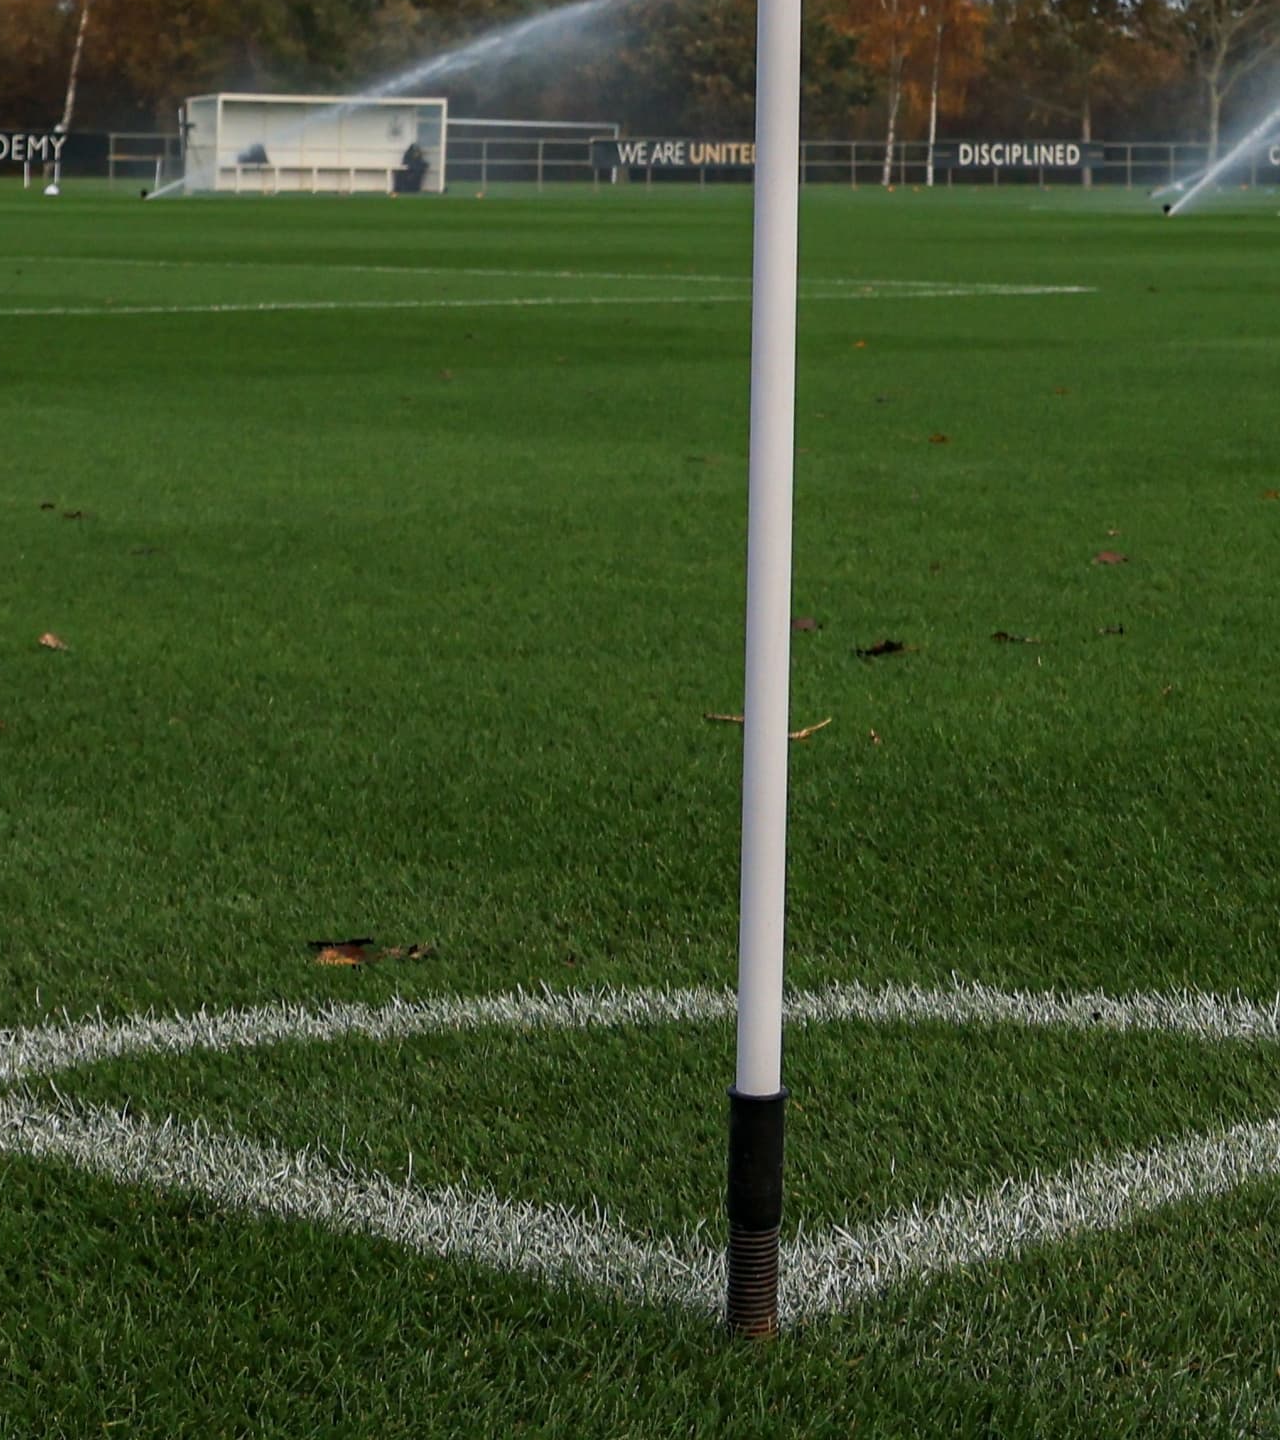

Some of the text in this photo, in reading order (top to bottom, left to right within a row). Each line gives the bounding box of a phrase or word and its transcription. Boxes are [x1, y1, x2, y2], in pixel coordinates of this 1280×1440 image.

[618, 141, 647, 165] WE
[651, 141, 685, 165] ARE
[958, 142, 1080, 166] DISCIPLINED
